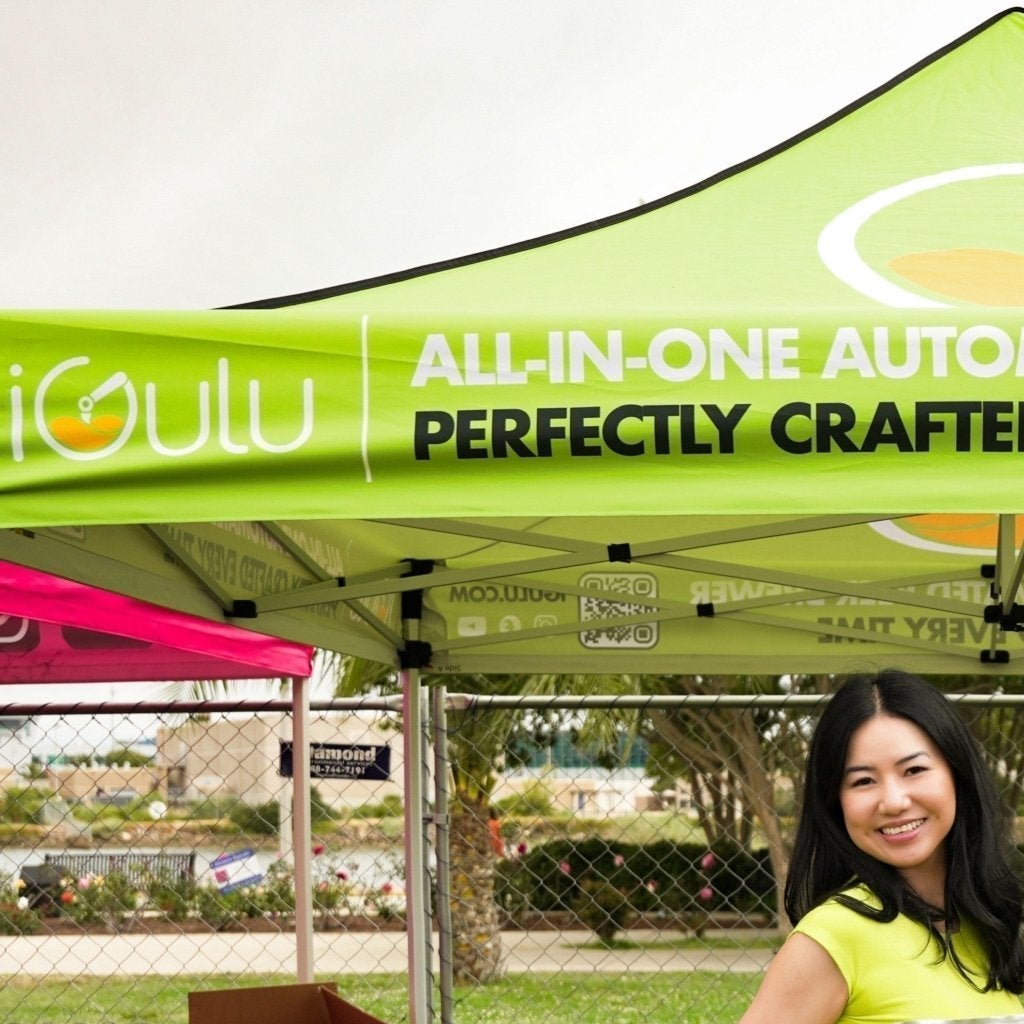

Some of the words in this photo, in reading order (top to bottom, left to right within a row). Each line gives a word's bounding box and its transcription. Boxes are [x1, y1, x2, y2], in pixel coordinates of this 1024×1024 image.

[410, 327, 800, 387] ALL-IN-ONE
[10, 355, 313, 463] iGulu
[414, 402, 752, 460] PERFECTLY
[310, 746, 376, 761] amond
